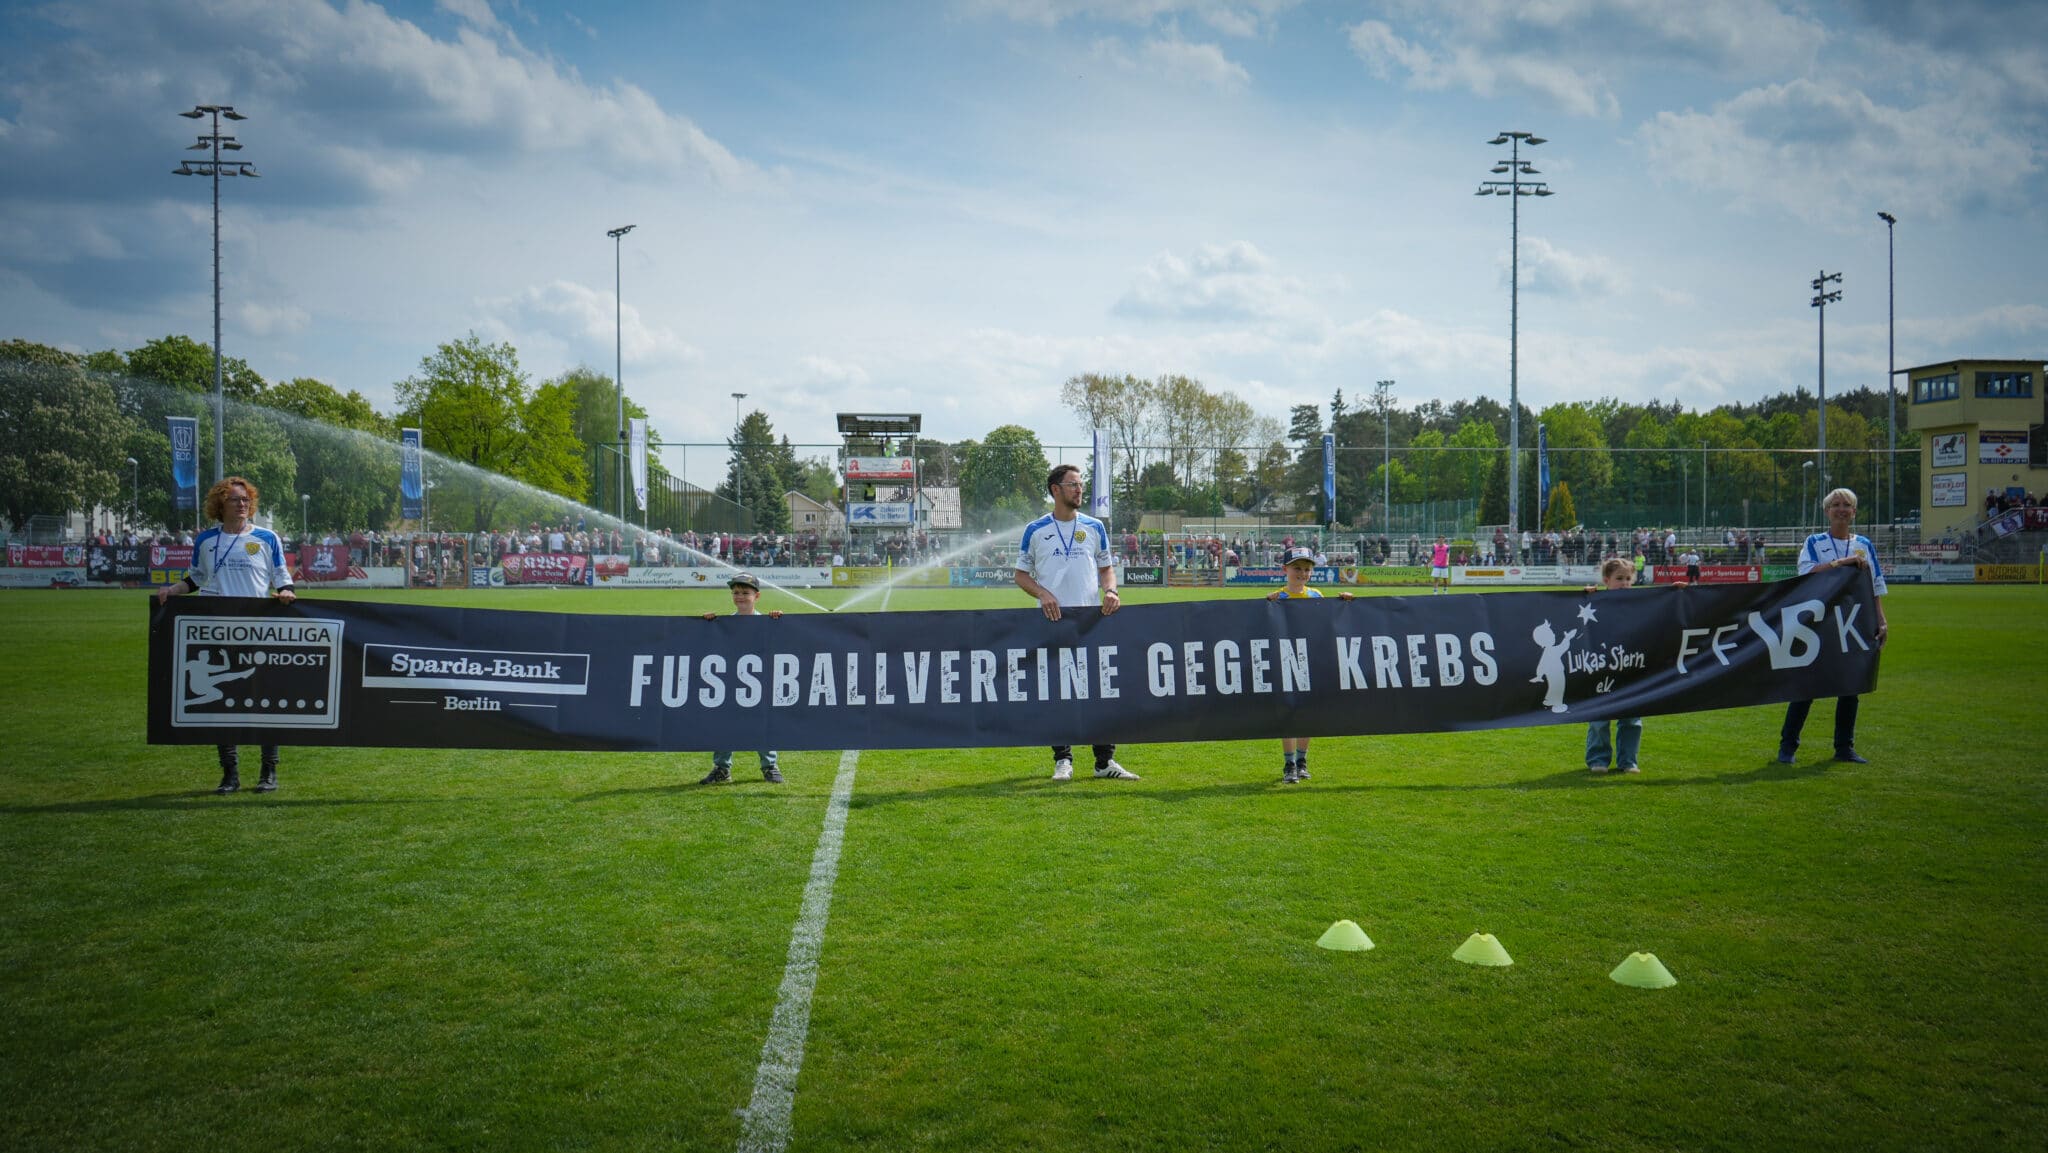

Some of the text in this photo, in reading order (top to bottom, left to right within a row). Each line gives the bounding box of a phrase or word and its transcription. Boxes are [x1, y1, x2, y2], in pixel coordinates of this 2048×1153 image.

[186, 625, 331, 642] REGIONALLIGA
[239, 651, 327, 666] NORDOST
[391, 652, 561, 679] Sparda-Bank
[630, 631, 1499, 707] FUSSBALLVEREINE GEGEN KREBS
[1609, 644, 1645, 672] Stern
[443, 696, 501, 711] Berlin
